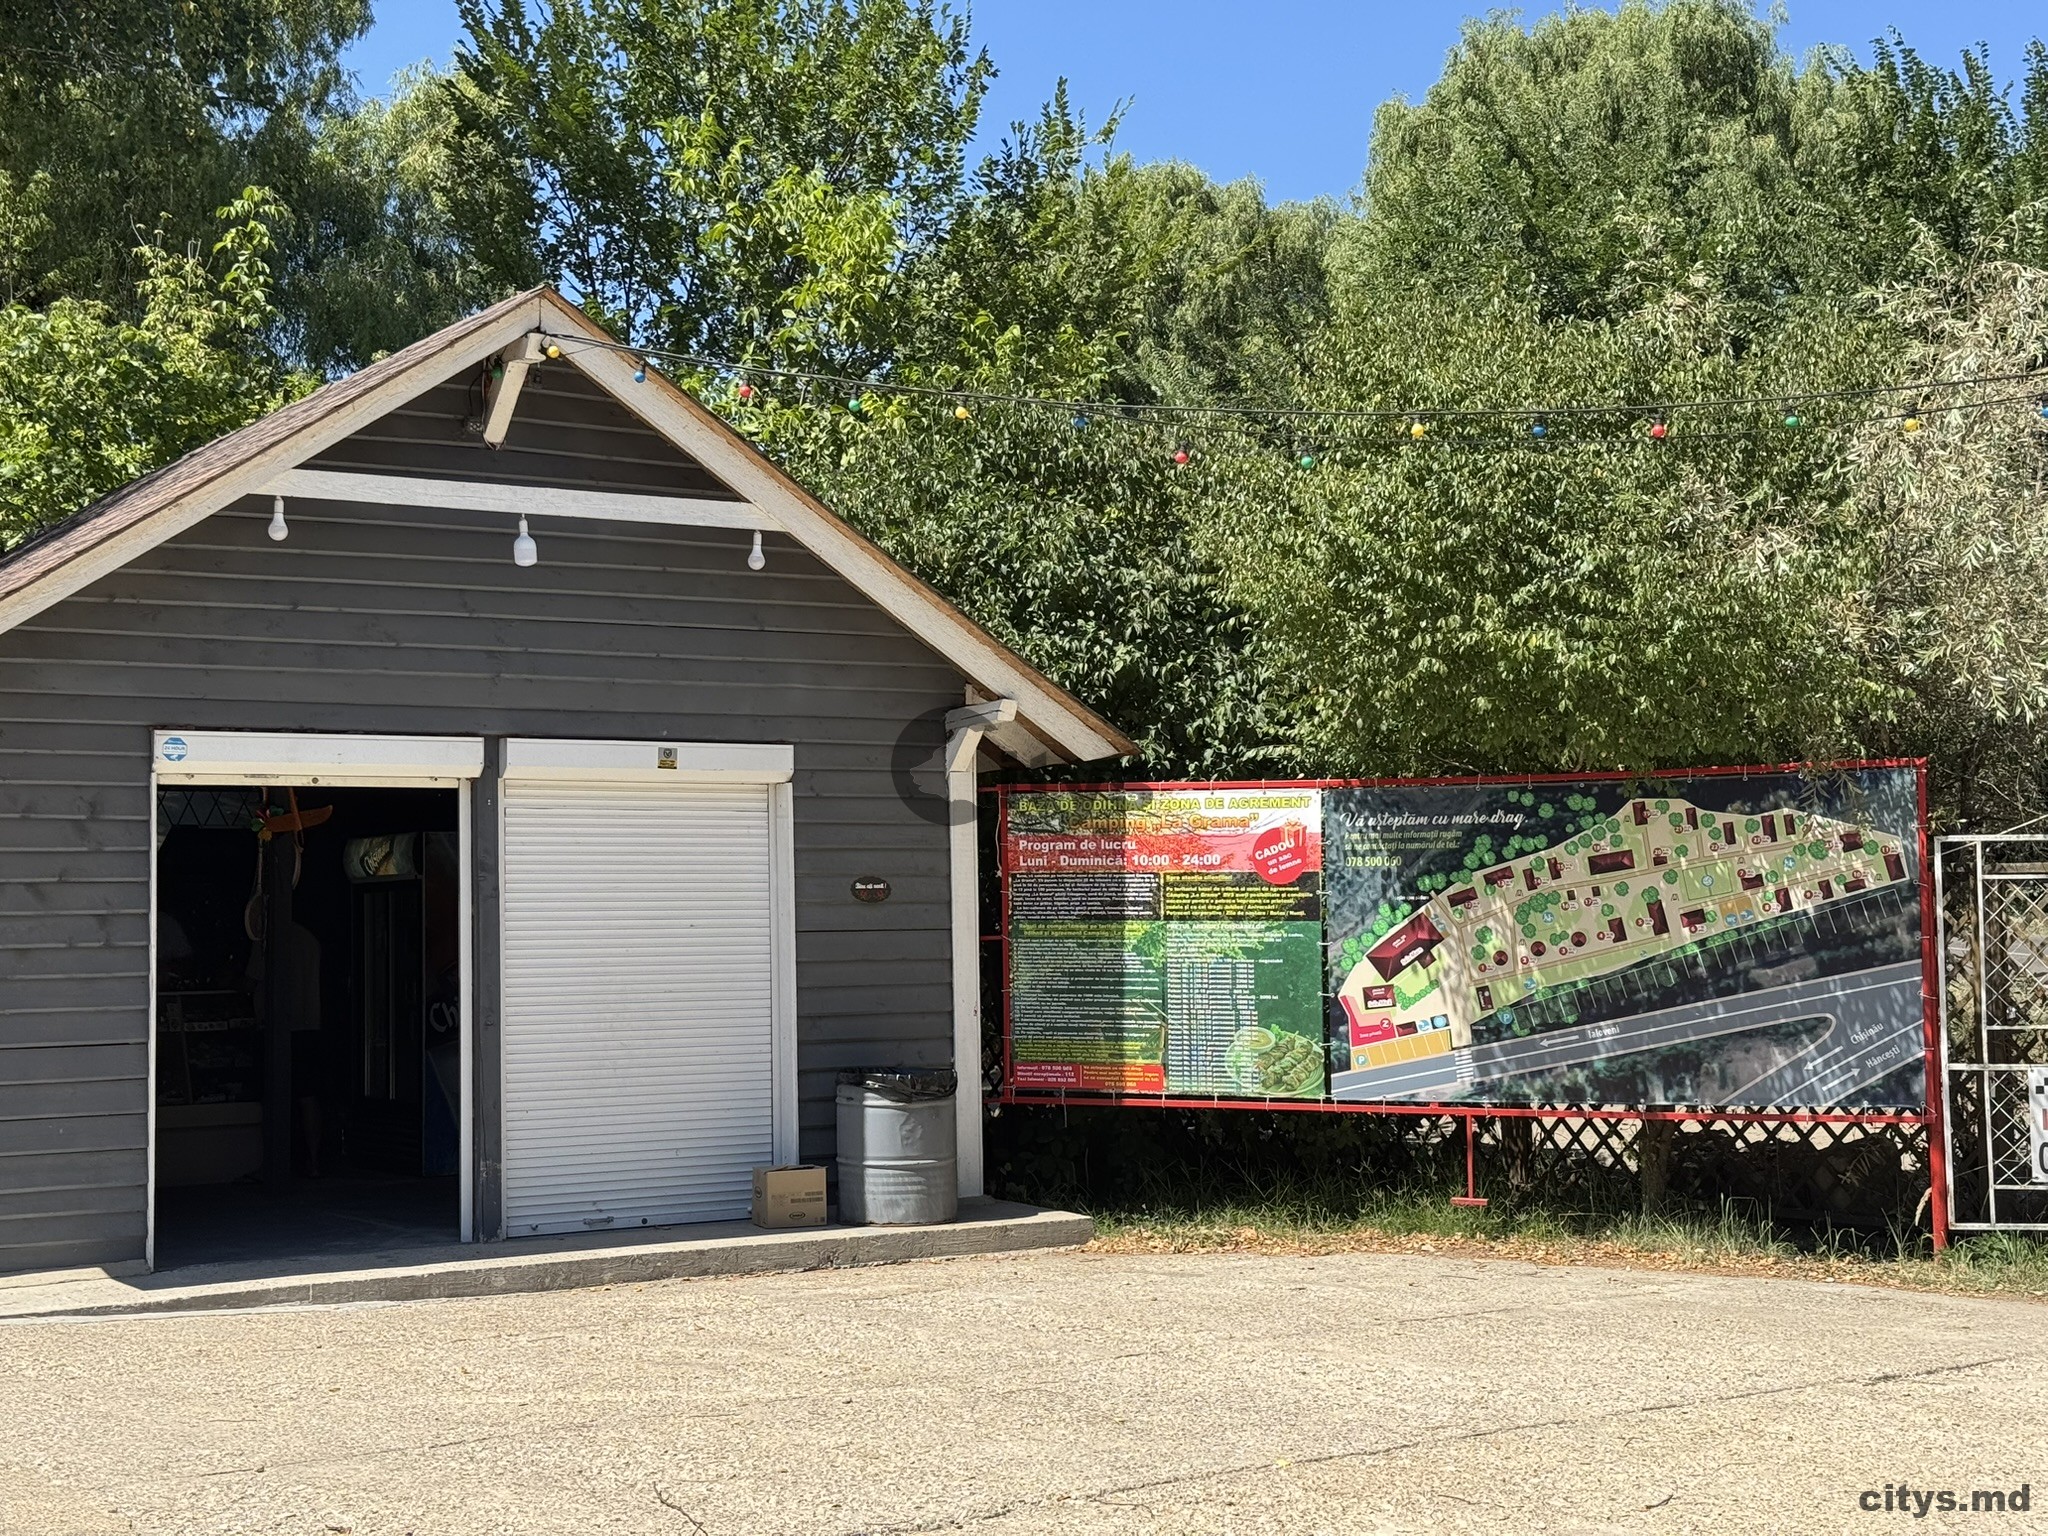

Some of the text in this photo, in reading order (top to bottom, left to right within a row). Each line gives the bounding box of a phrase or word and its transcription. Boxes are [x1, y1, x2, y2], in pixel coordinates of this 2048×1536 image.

[1019, 800, 1056, 812] BAZA
[1060, 800, 1079, 811] DE
[1161, 799, 1201, 810] ZONA
[1205, 798, 1224, 810] DE
[1228, 796, 1312, 809] AGREMENT
[1068, 815, 1147, 832] Camping
[1432, 815, 1450, 826] cu
[1451, 810, 1489, 825] mare
[1490, 808, 1528, 831] drag.
[1383, 830, 1403, 840] multe
[1019, 840, 1137, 853] Program de lucru
[1255, 838, 1295, 860] CADOU
[1398, 841, 1405, 849] la
[1436, 840, 1446, 849] de
[1019, 855, 1048, 866] Luni
[1060, 855, 1127, 866] Duminică:
[1132, 854, 1170, 866] 10:00
[1182, 854, 1221, 866] 24:00
[1345, 855, 1402, 867] 078 500 060
[1503, 1013, 1509, 1021] P
[1588, 1026, 1620, 1039] Ialoveni
[1358, 1057, 1365, 1065] P
